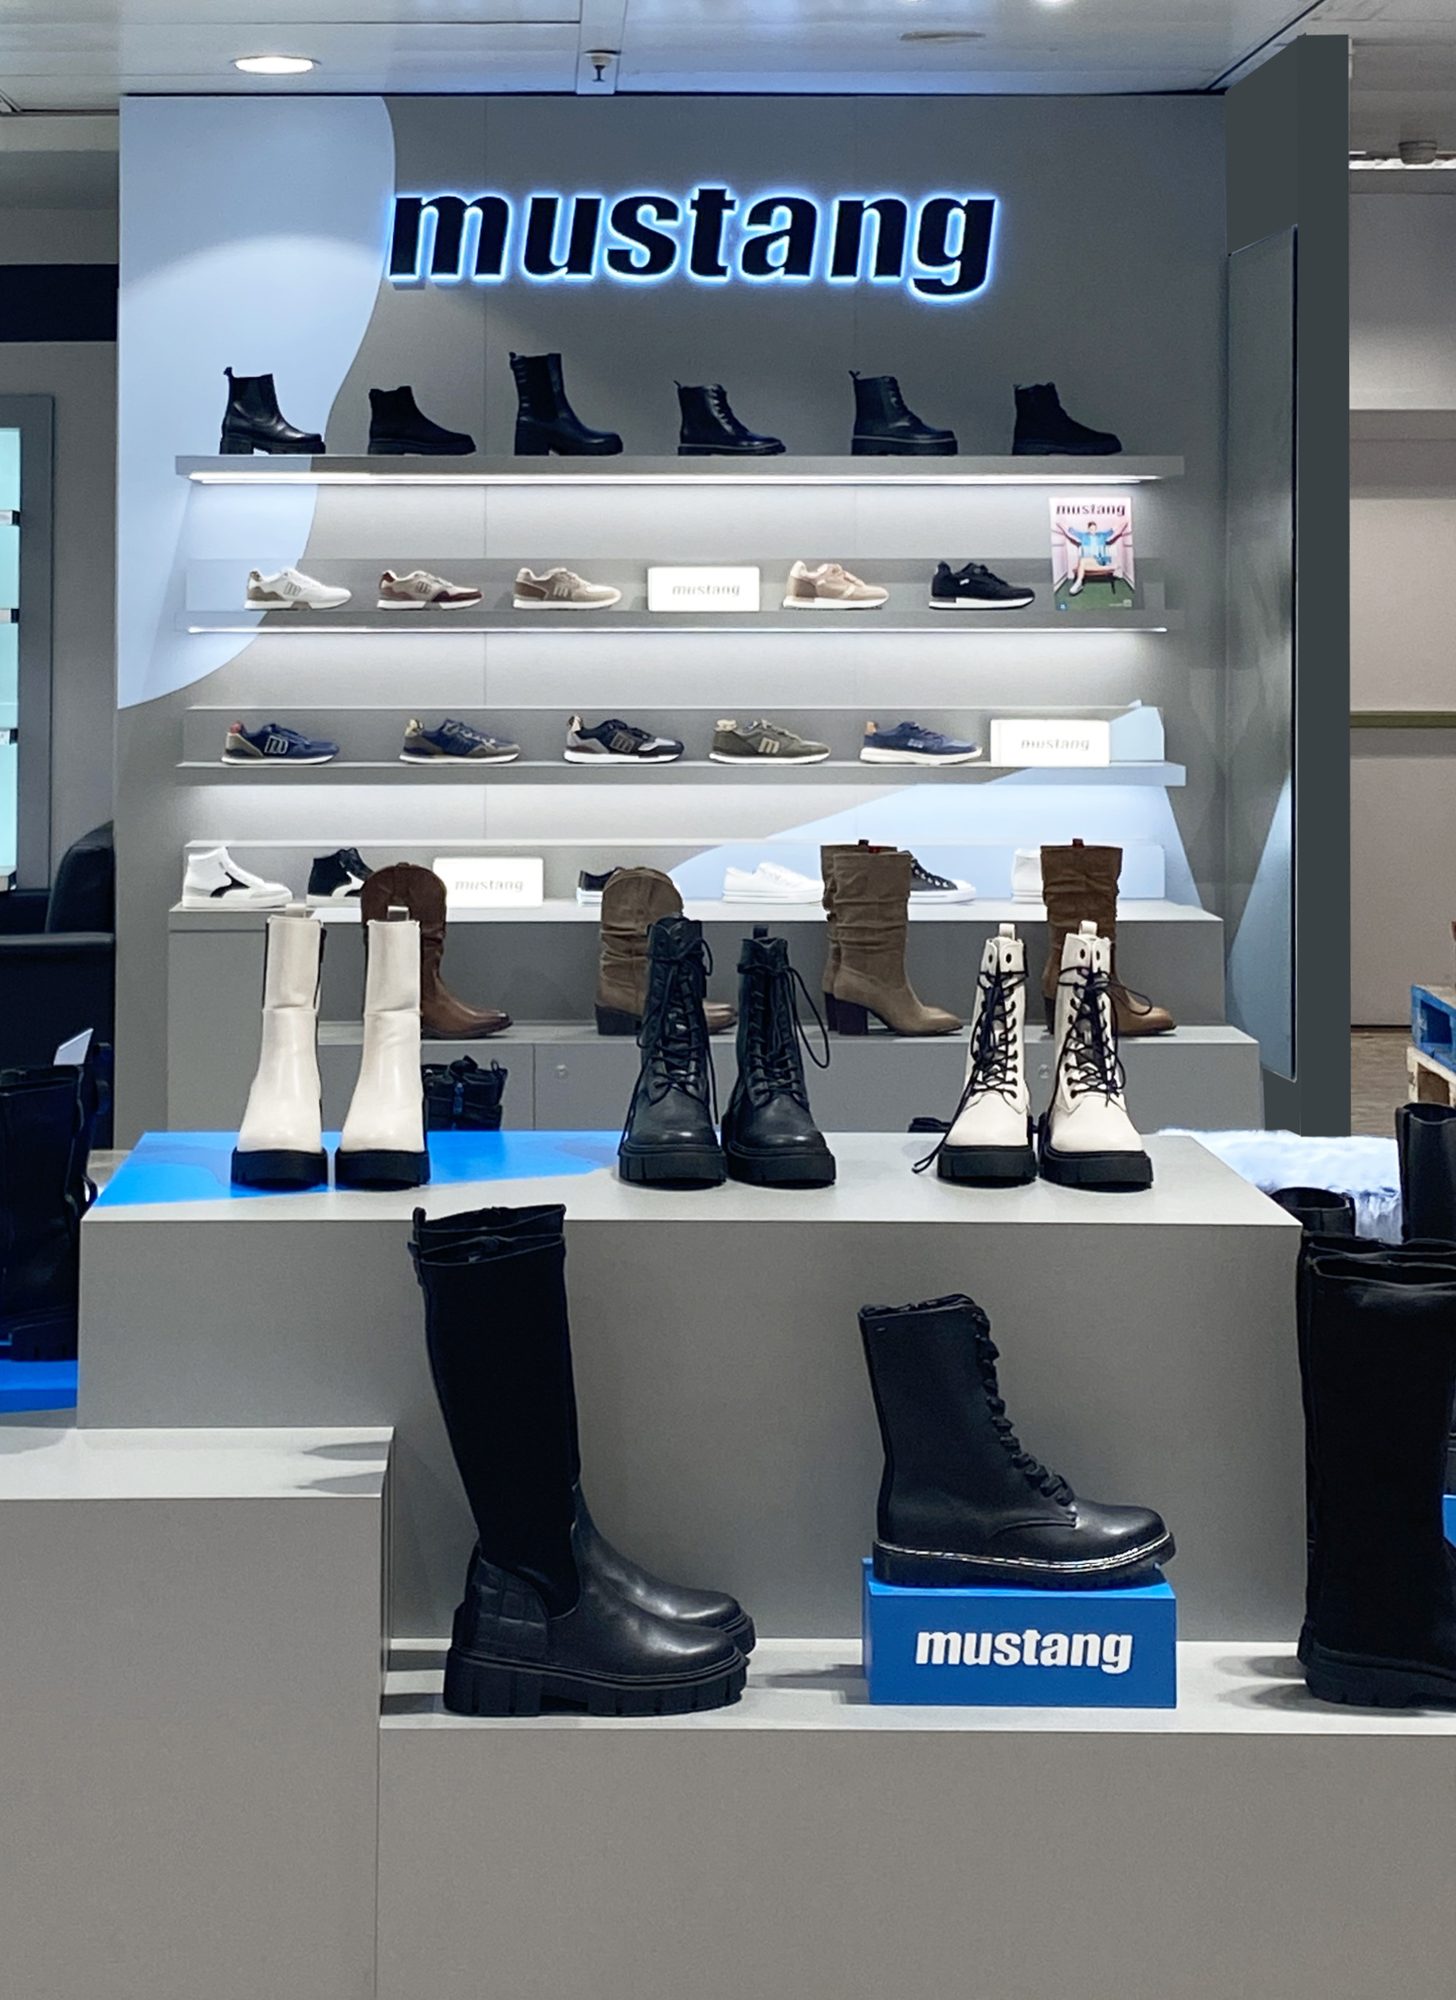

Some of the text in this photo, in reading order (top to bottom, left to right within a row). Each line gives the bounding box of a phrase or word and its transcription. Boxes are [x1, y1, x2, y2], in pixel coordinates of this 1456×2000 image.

[390, 187, 996, 296] mustang
[1056, 505, 1126, 517] mustang
[671, 585, 740, 597] mustang
[915, 1629, 1133, 1674] mustang
